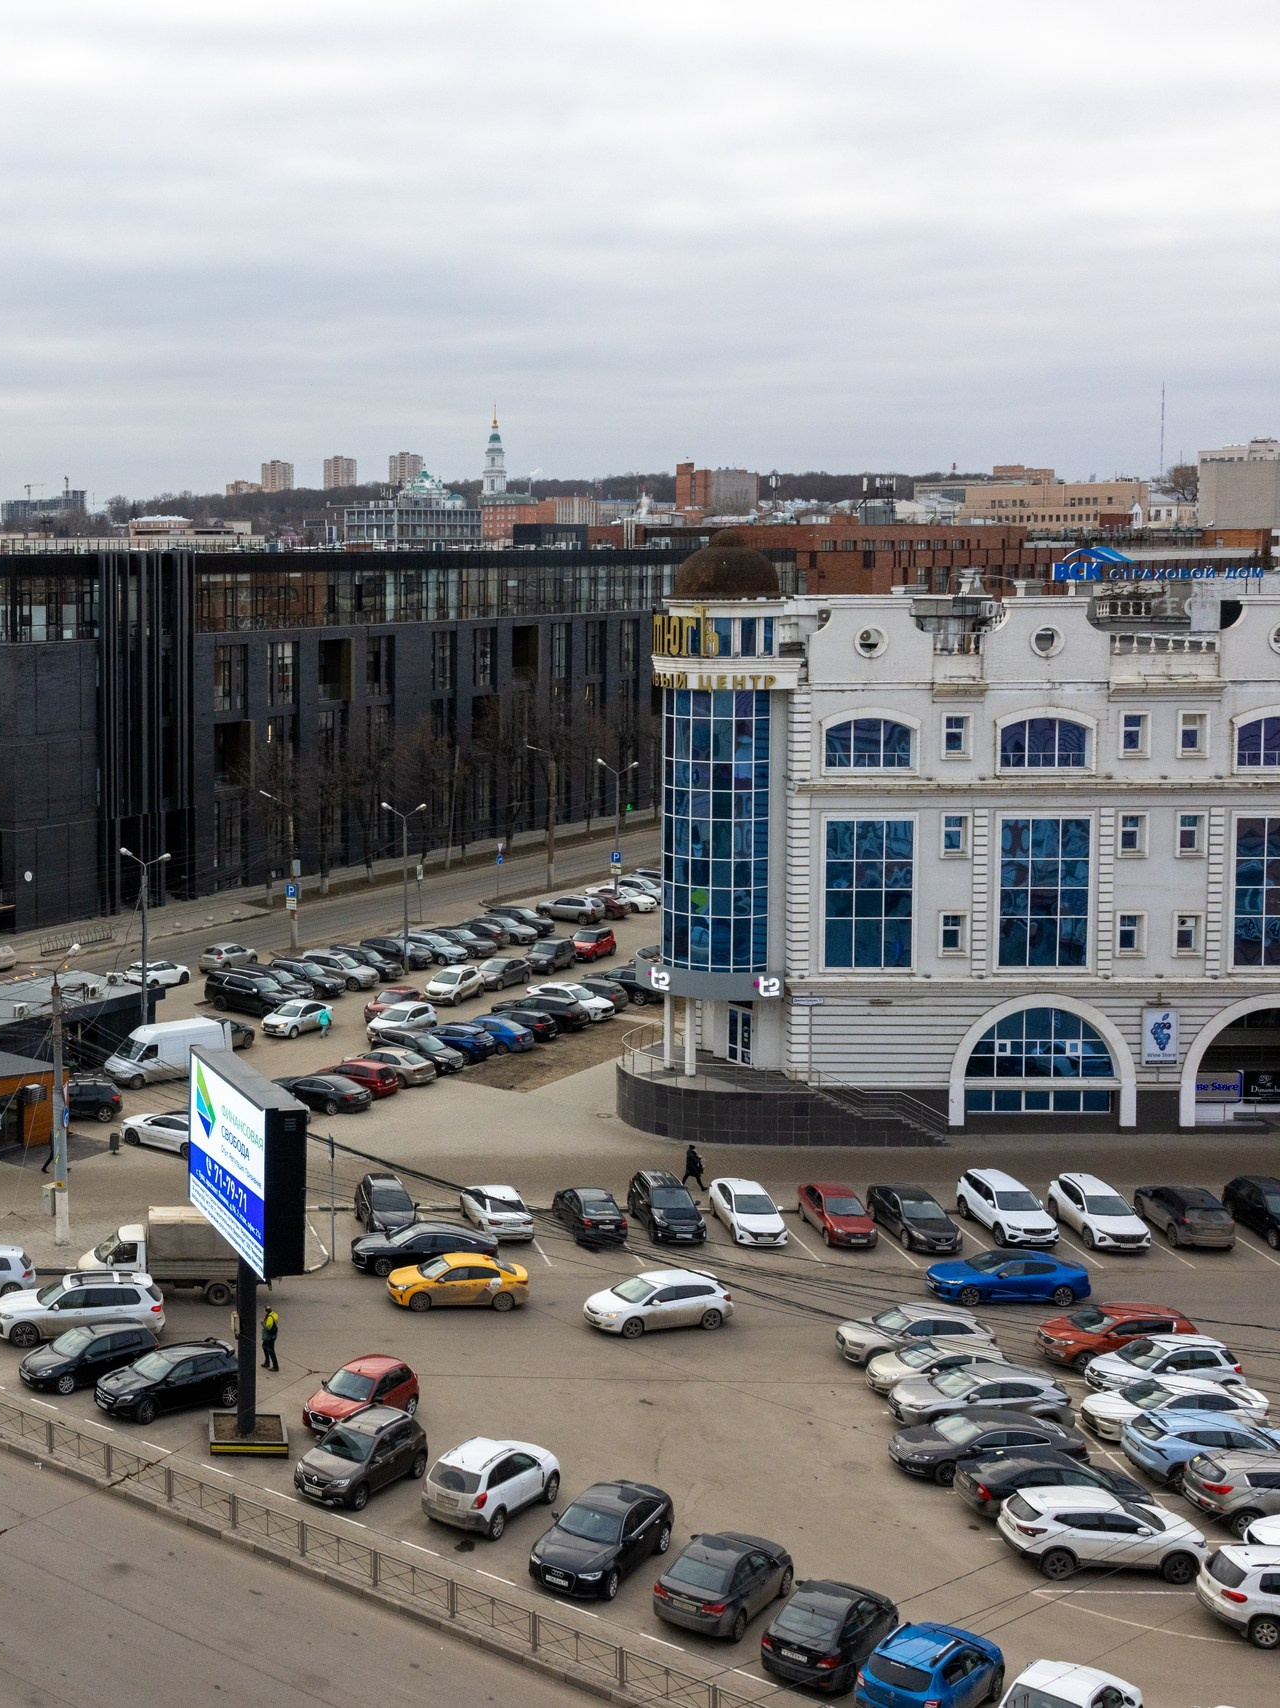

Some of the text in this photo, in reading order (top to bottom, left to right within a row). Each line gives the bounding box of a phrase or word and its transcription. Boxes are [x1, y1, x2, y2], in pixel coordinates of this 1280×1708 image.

[1052, 562, 1264, 581] ВСК СТРАХОВОЙ ДОМ
[652, 671, 777, 694] ВЫЙ ЦЕНТР
[1210, 1082, 1239, 1091] Store
[221, 1104, 264, 1151] ФИНАНСОВАЯ
[220, 1125, 250, 1161] СВОБОДА
[213, 1163, 247, 1214] 71-79-71
